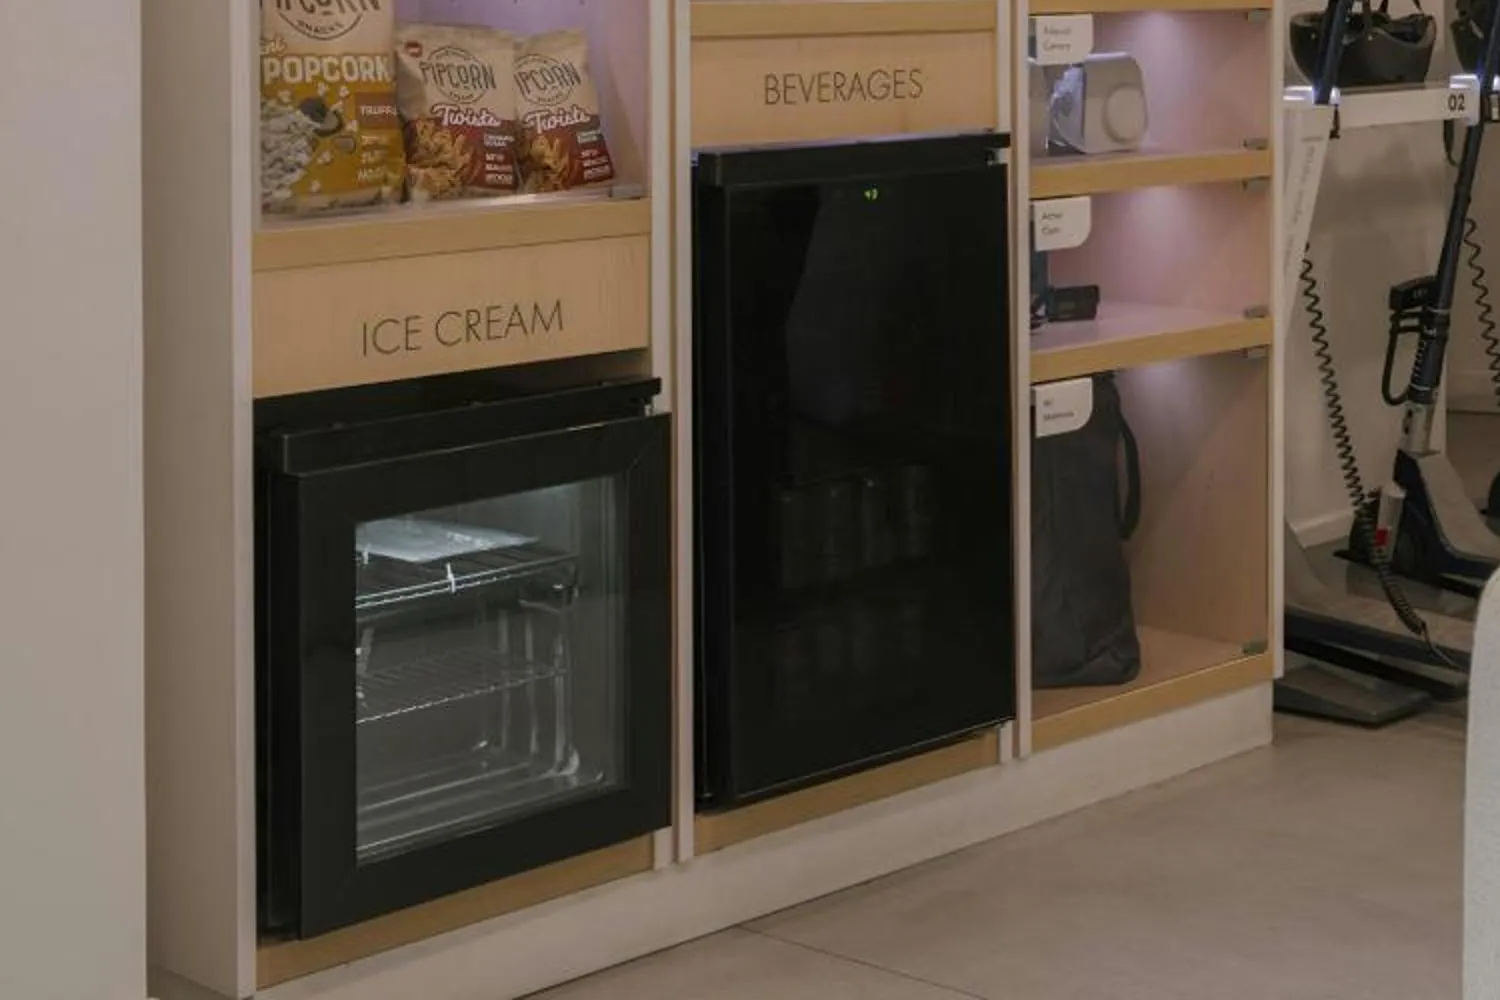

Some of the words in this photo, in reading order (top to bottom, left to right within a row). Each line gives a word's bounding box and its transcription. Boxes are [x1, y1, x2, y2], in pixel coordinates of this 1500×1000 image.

[262, 55, 393, 85] POPCORN
[418, 60, 497, 90] PIPCORN
[513, 60, 582, 95] IPCORN
[764, 68, 924, 106] BEVERAGES
[1448, 93, 1465, 111] 02
[431, 103, 501, 128] Twists
[524, 104, 592, 134] Twists
[362, 314, 422, 357] ICE
[434, 299, 564, 348] CREAM
